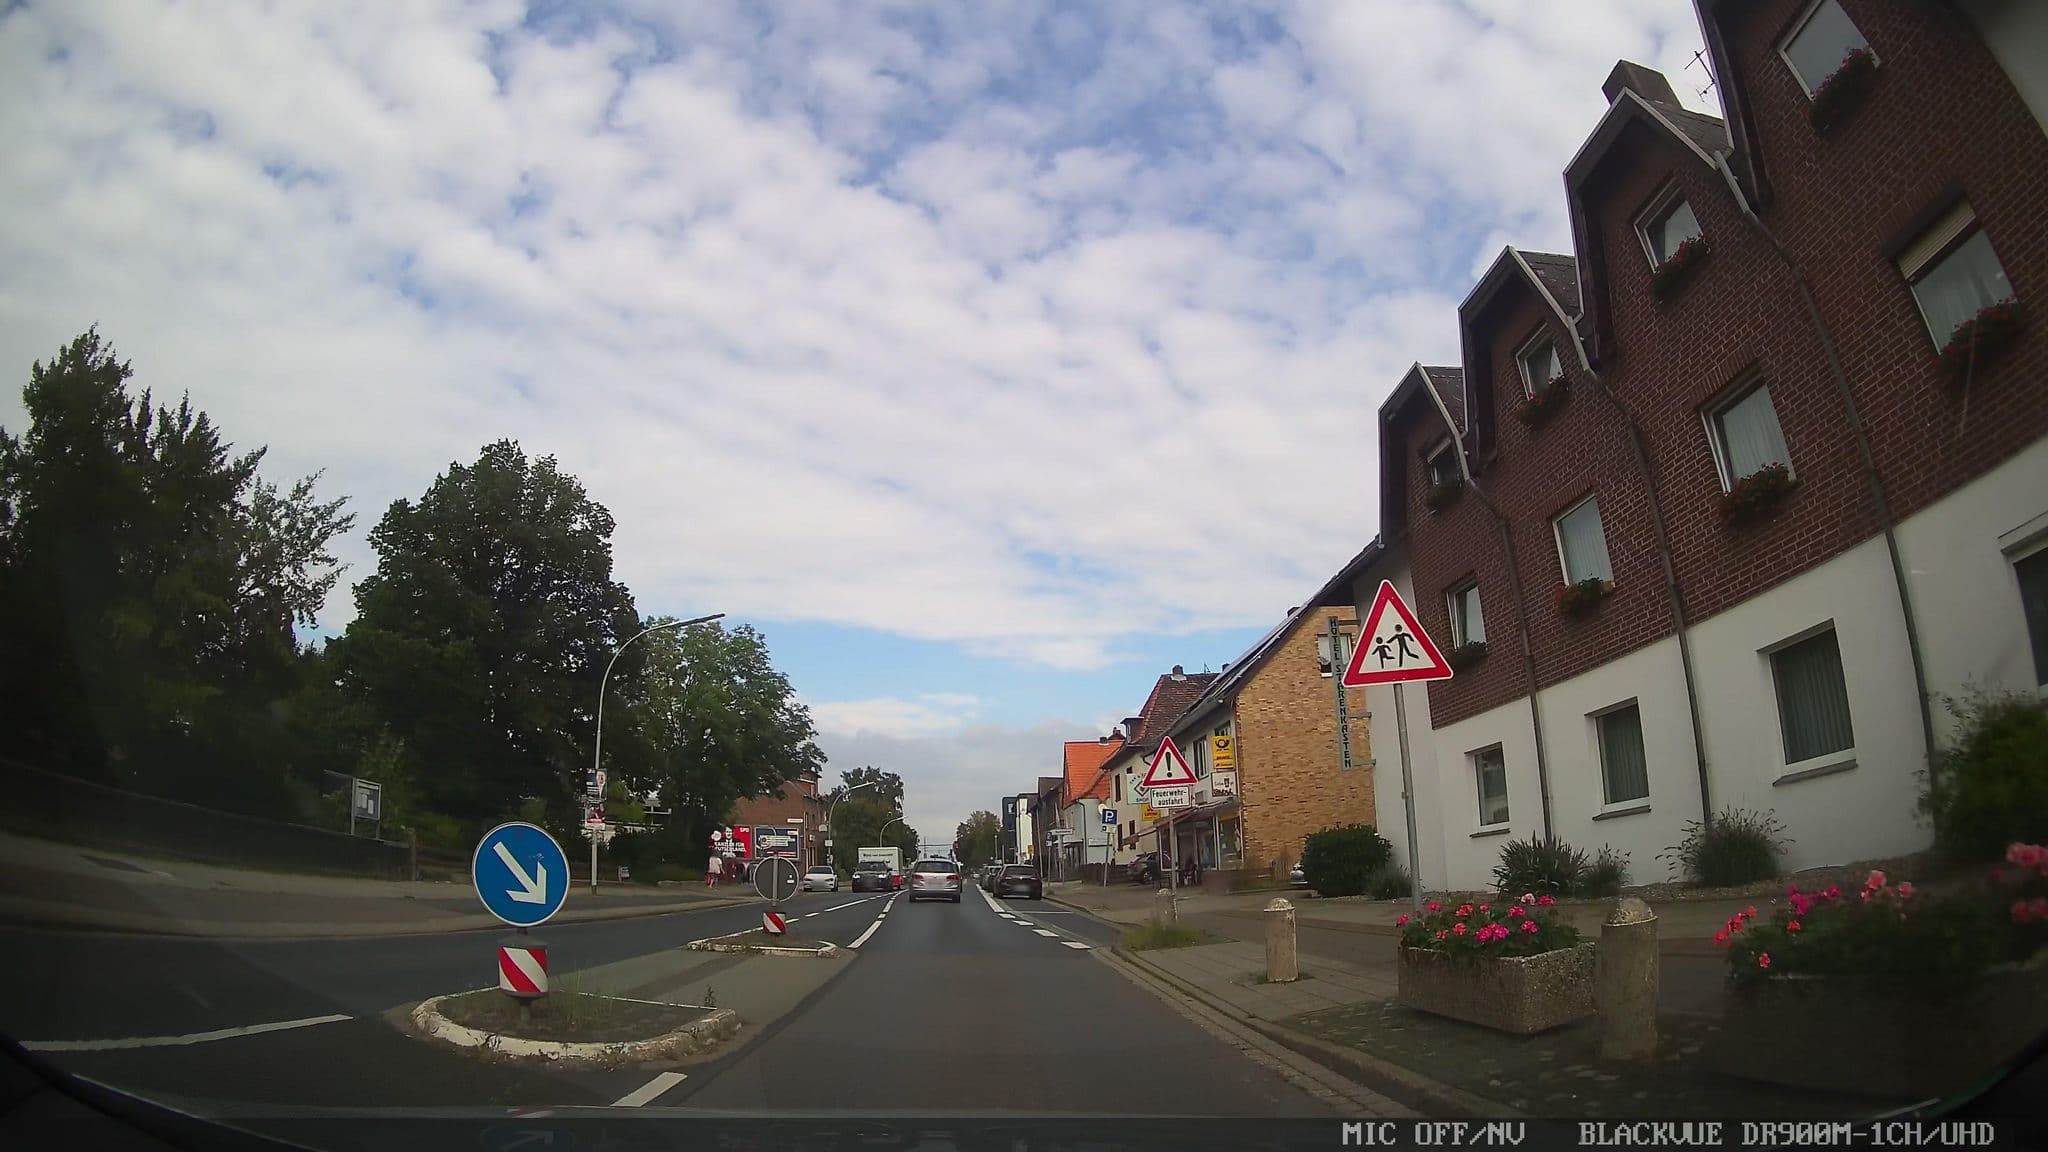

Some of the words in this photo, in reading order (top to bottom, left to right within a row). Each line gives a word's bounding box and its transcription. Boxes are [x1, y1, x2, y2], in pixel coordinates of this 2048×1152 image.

[1330, 618, 1340, 660] HOTEL
[1335, 664, 1351, 768] STARENKASTEN
[1152, 789, 1187, 798] Feuerwehr-
[1158, 797, 1184, 806] ausfahrt
[1105, 810, 1114, 823] P
